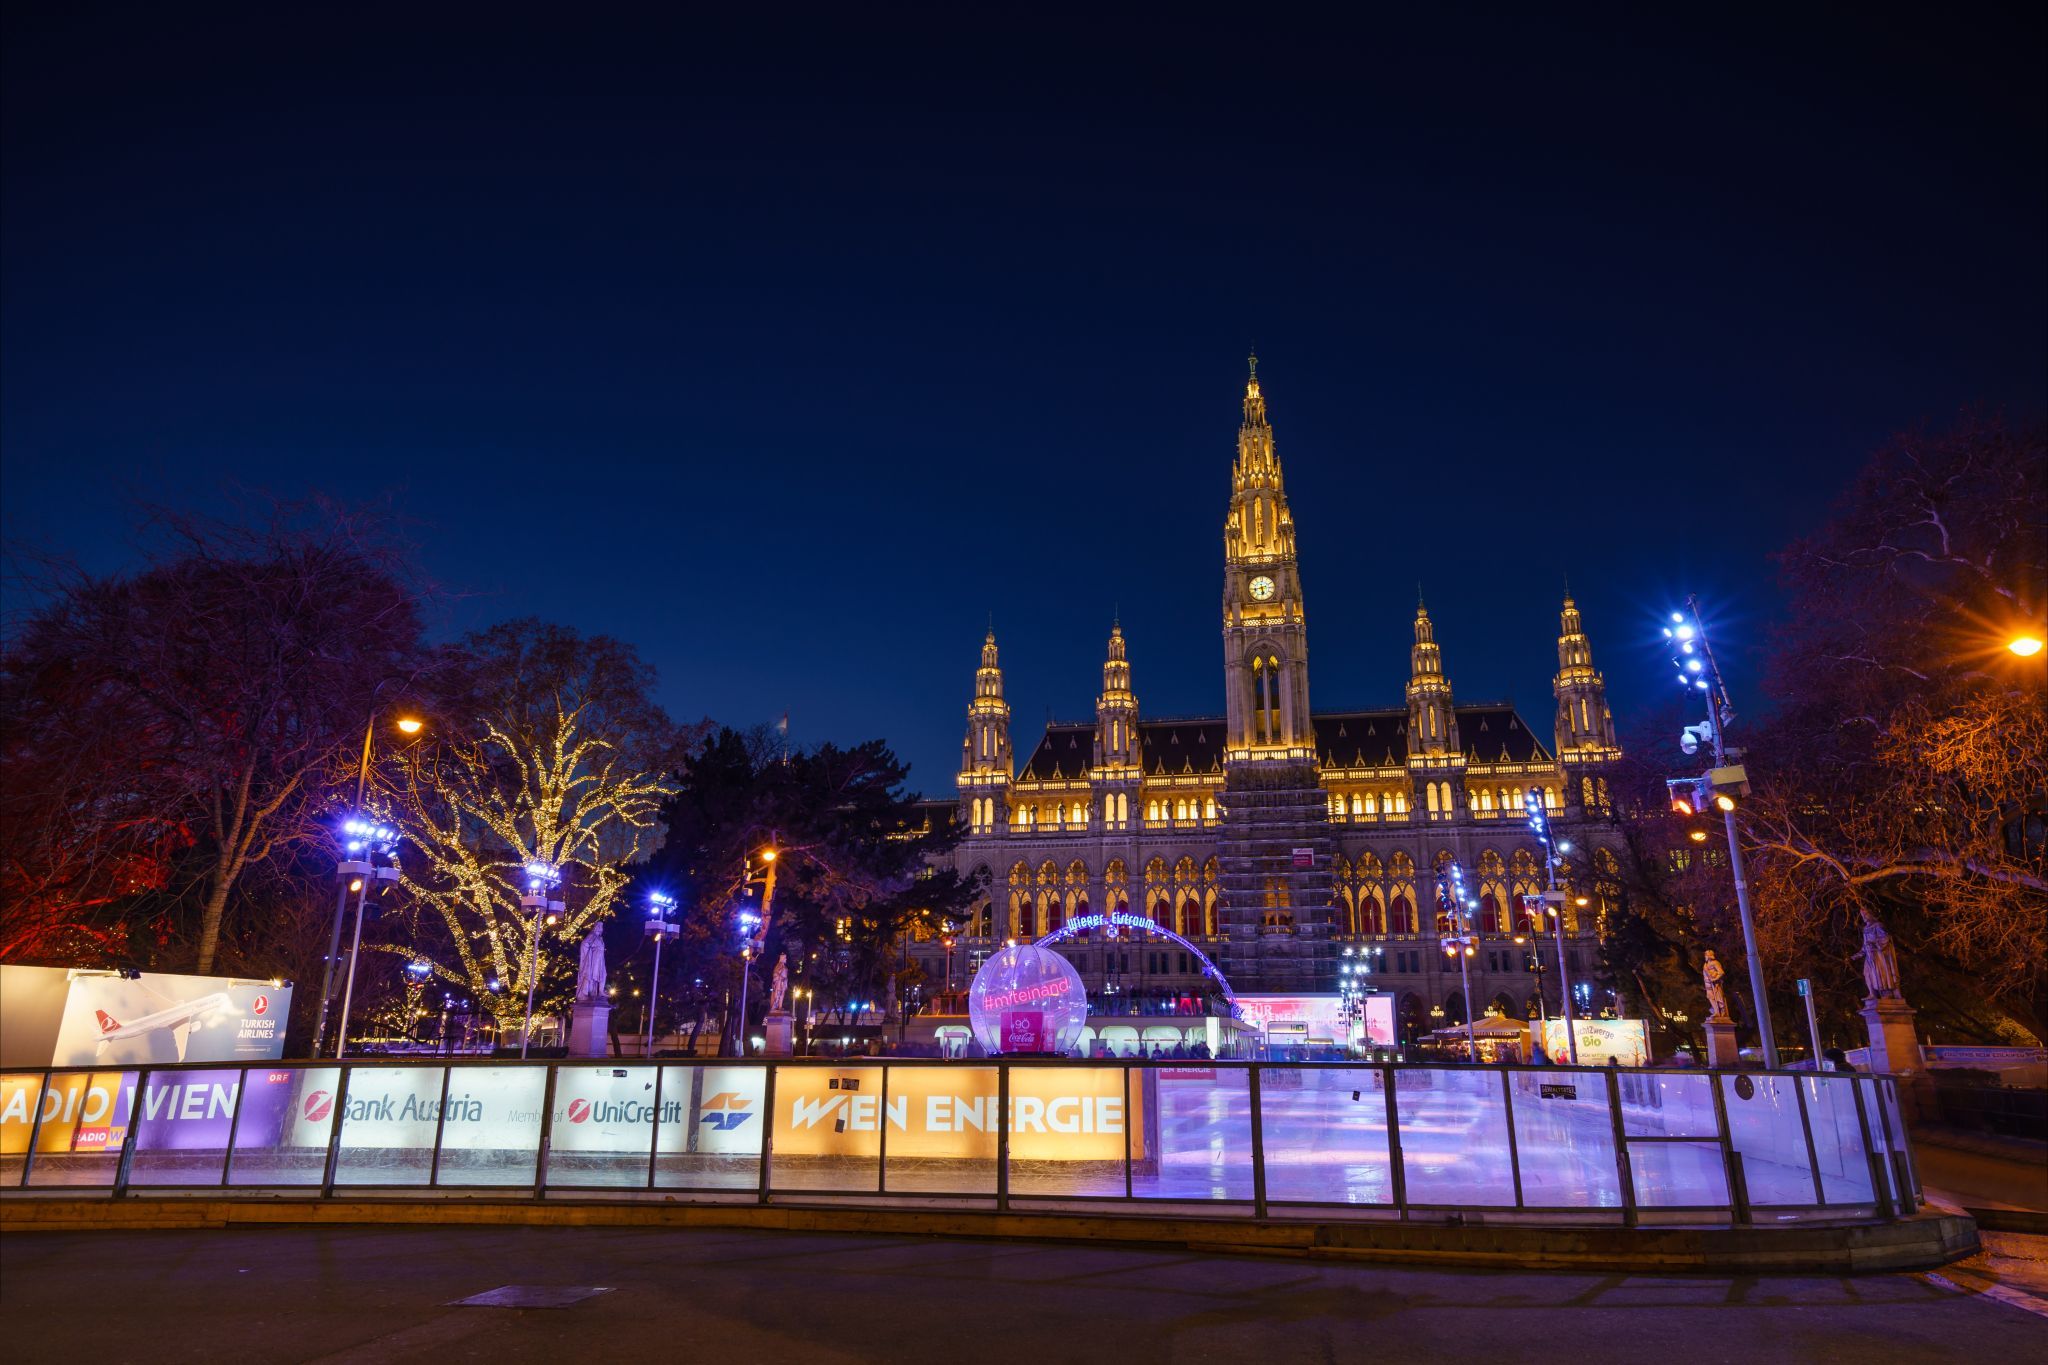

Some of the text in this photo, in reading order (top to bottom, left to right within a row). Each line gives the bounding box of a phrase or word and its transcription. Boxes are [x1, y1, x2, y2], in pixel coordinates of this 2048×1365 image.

[1067, 912, 1155, 930] Wiener Eistraum
[985, 977, 1068, 1010] #miteinand
[240, 1019, 275, 1029] TURKISH
[237, 1029, 274, 1039] AIRLINES
[1582, 1035, 1602, 1047] Bio
[269, 1074, 289, 1082] ORF
[0, 1082, 239, 1124] ADIO WIEN
[340, 1093, 482, 1123] Bank Austria
[508, 1109, 553, 1123] Memb
[593, 1100, 682, 1125] UniCredit
[792, 1094, 1123, 1134] WIEN ENERGIE
